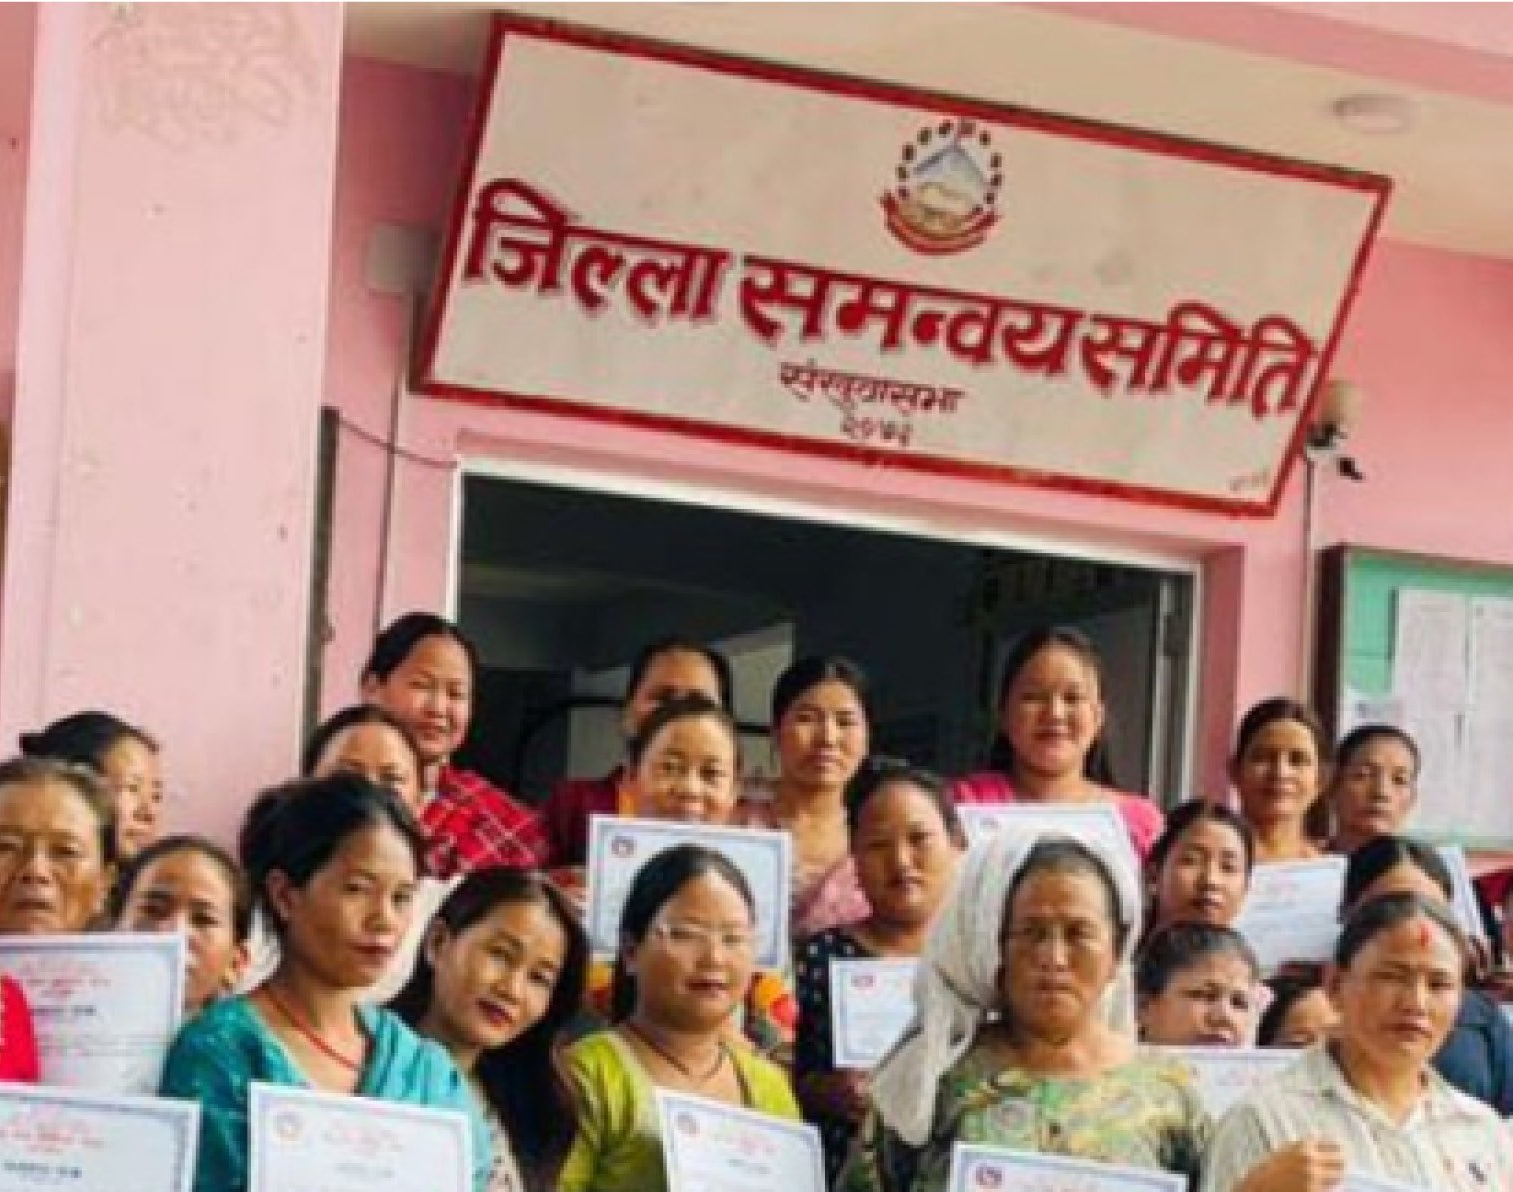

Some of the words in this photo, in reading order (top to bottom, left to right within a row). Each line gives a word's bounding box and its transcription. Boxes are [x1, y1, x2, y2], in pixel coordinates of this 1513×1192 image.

[463, 177, 730, 322] जिल्ला
[738, 252, 1077, 371] समन्वय
[1078, 301, 1316, 417] समिति
